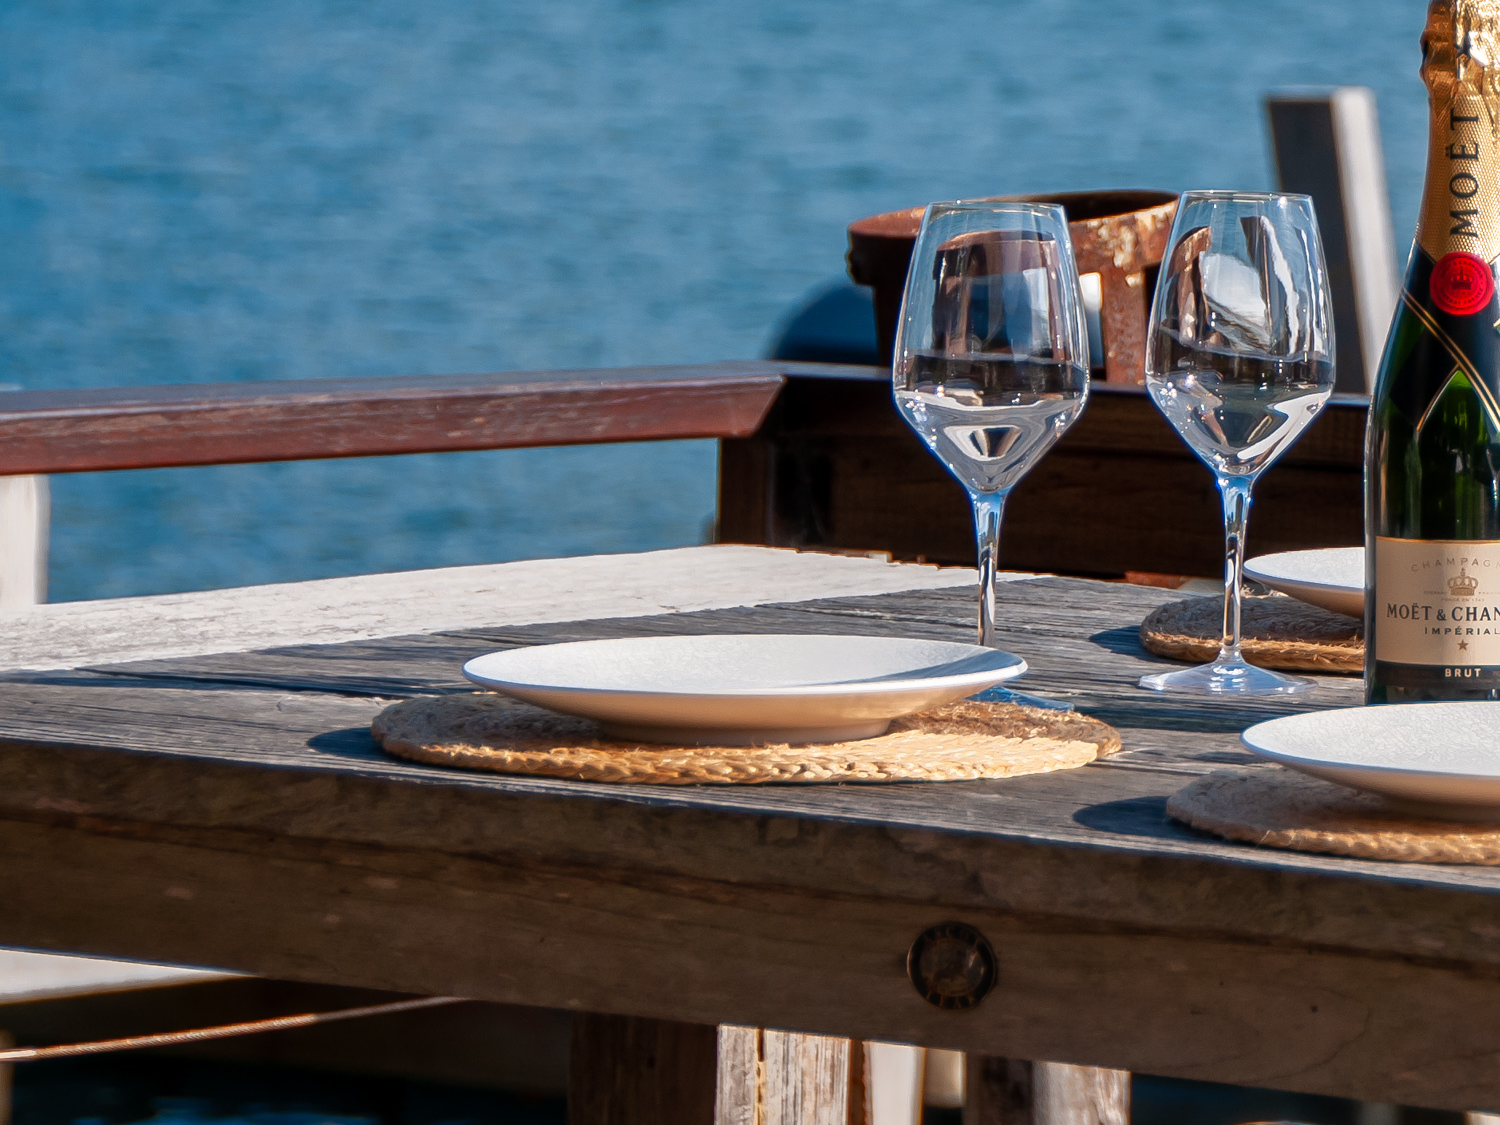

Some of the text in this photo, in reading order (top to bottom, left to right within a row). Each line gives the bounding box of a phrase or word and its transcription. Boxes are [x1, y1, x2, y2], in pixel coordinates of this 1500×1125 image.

[1445, 107, 1480, 238] MOËT
[1386, 602, 1433, 621] MOËT
[1436, 608, 1447, 621] &
[1424, 626, 1500, 636] IMPÉRIAL
[1444, 667, 1482, 678] BRUT
